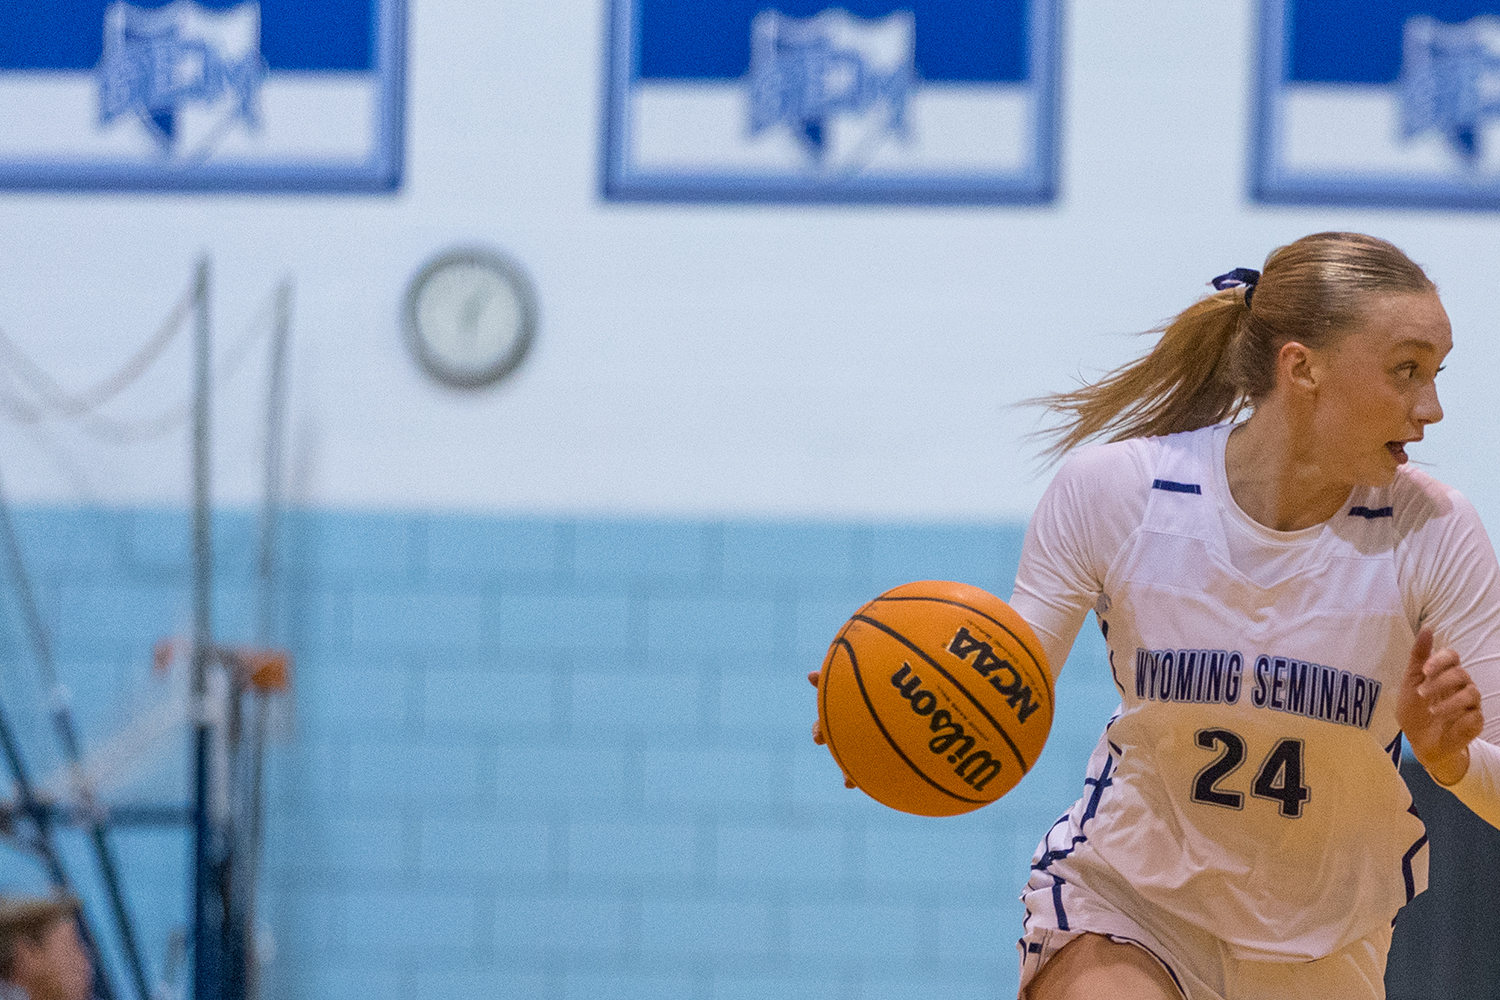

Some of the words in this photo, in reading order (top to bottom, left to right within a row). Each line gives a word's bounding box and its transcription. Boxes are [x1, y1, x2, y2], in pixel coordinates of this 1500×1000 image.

[946, 626, 1041, 725] NCAA
[1135, 648, 1244, 706] WYOMING
[1251, 653, 1382, 731] SEMINARY
[891, 661, 1002, 792] Wilson
[1190, 726, 1312, 819] 24
